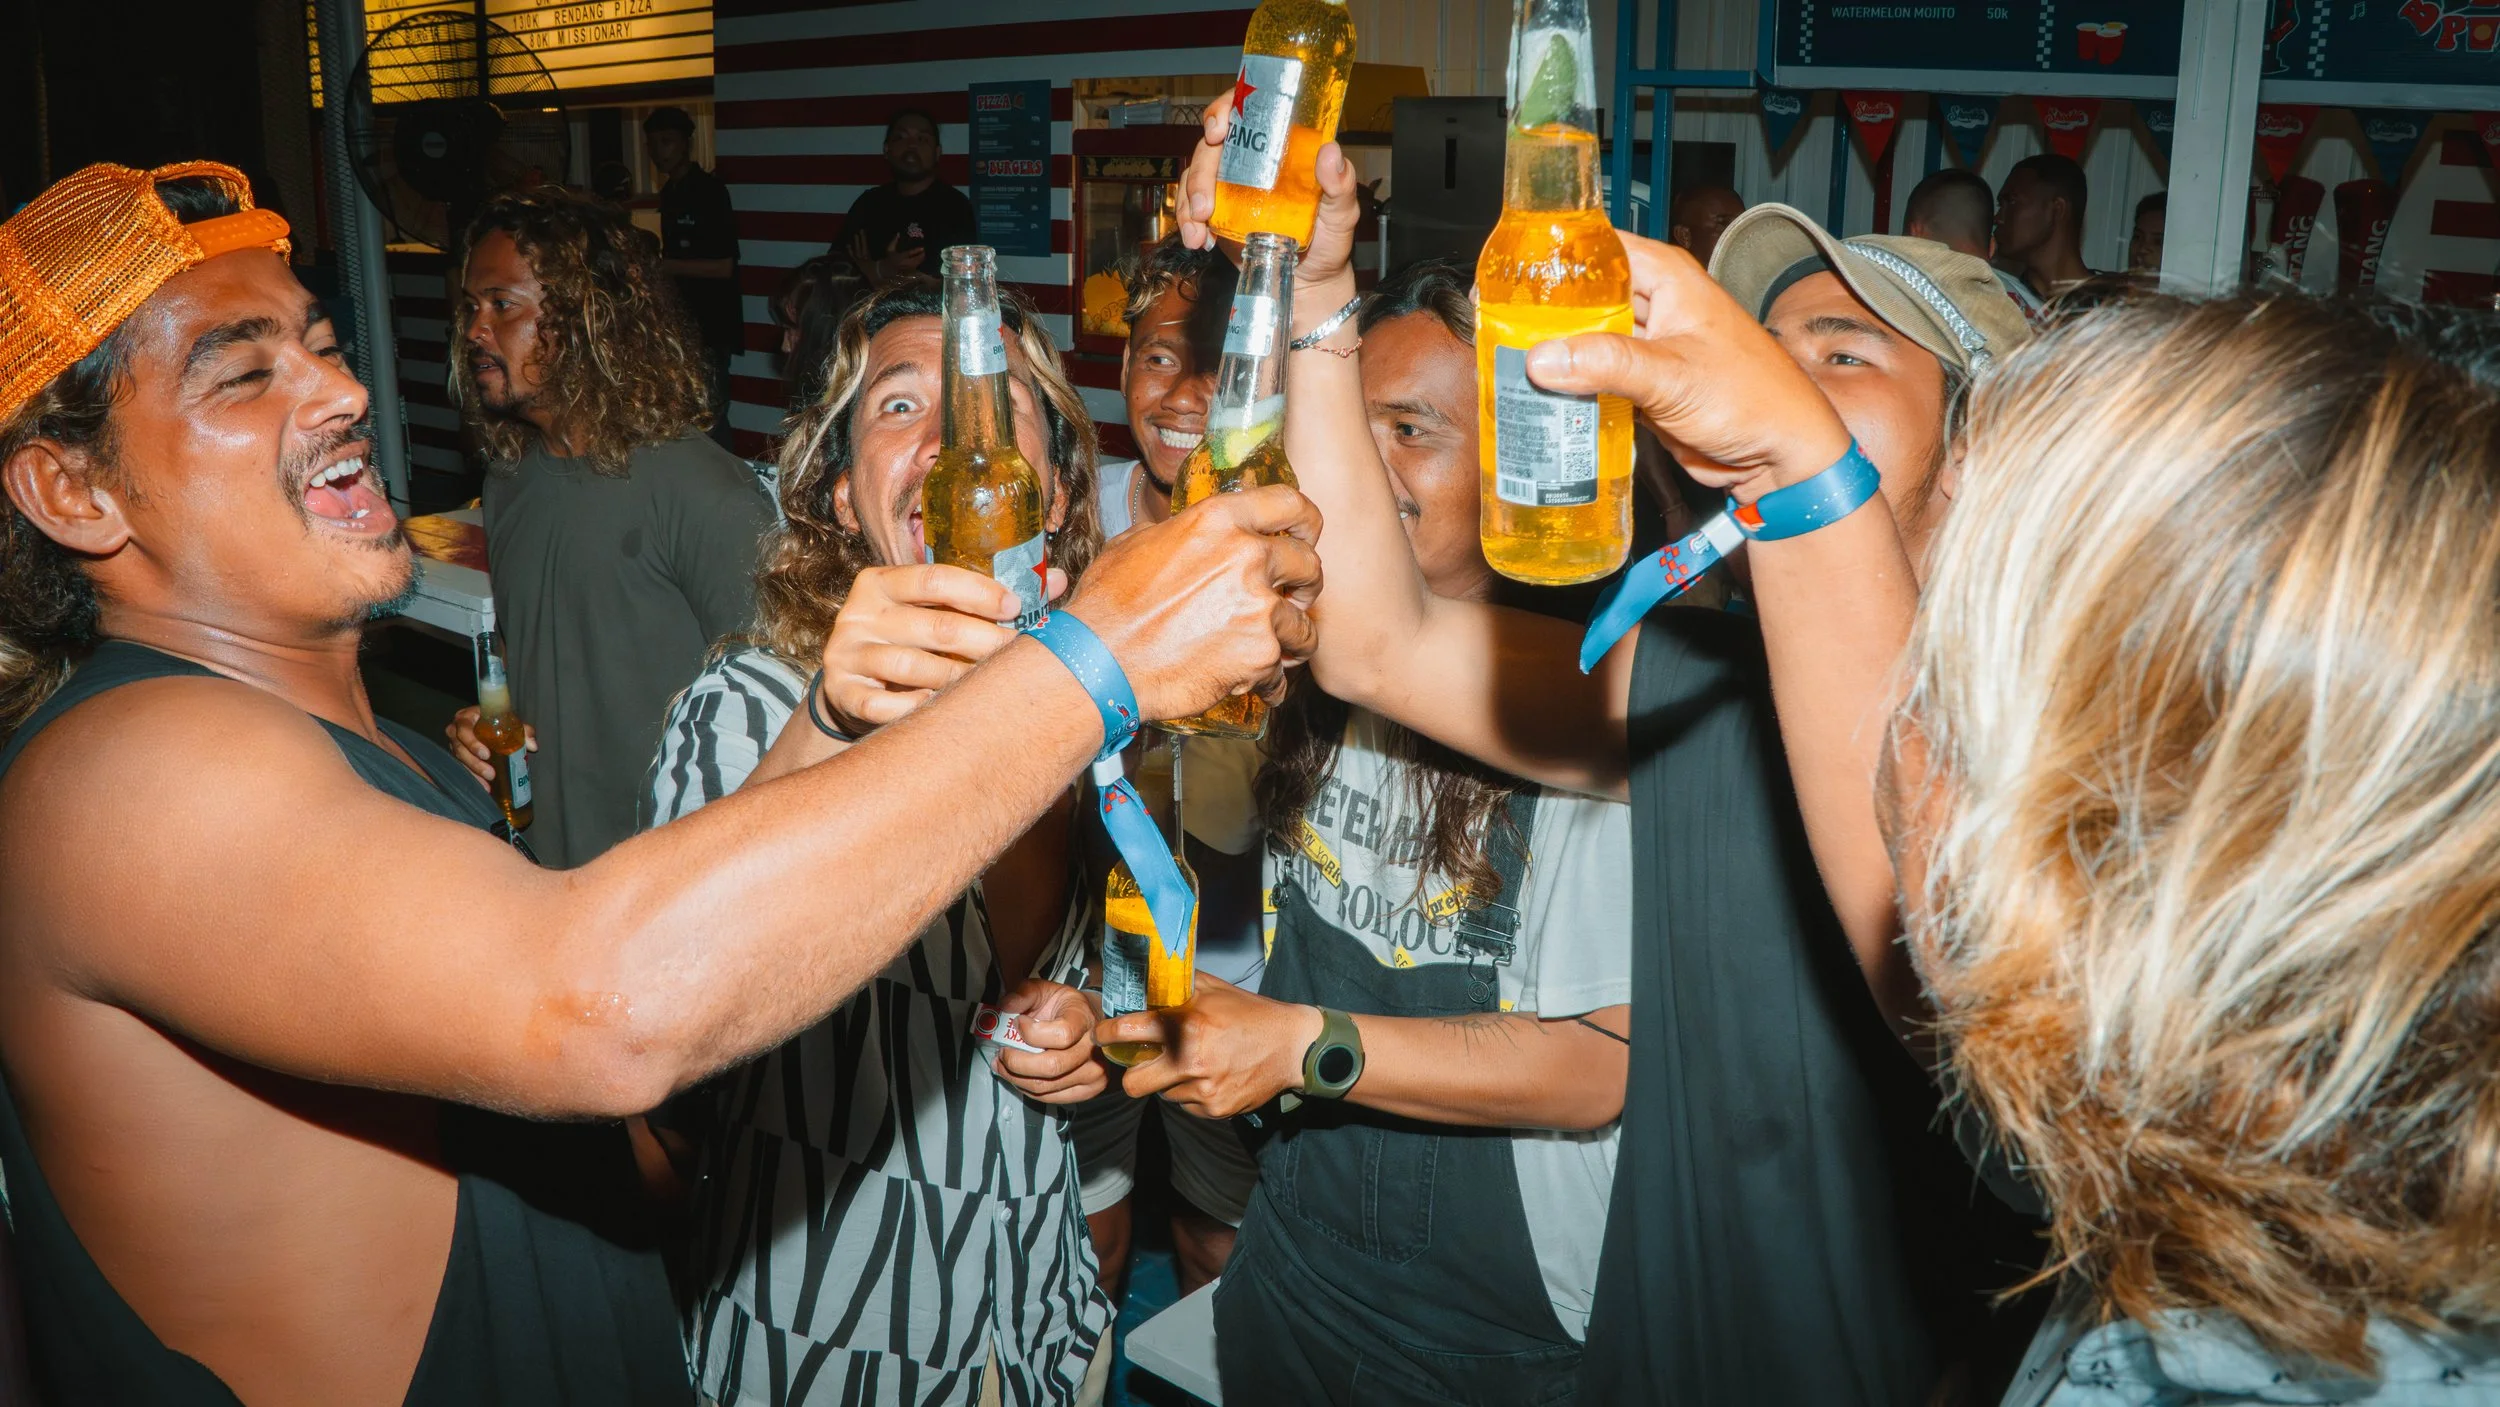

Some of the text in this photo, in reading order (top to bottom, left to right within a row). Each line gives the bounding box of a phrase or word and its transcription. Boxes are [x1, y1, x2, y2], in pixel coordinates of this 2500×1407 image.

[554, 4, 604, 25] RENDANG
[614, 0, 653, 17] PIZZA
[1831, 6, 2009, 20] WATERMELON MOJITO 50k
[557, 22, 631, 45] MISSIONARY
[976, 94, 1012, 111] PIZZA
[1225, 121, 1268, 153] TANG
[988, 160, 1044, 177] BURGERS
[1336, 878, 1499, 958] BOLLOC
